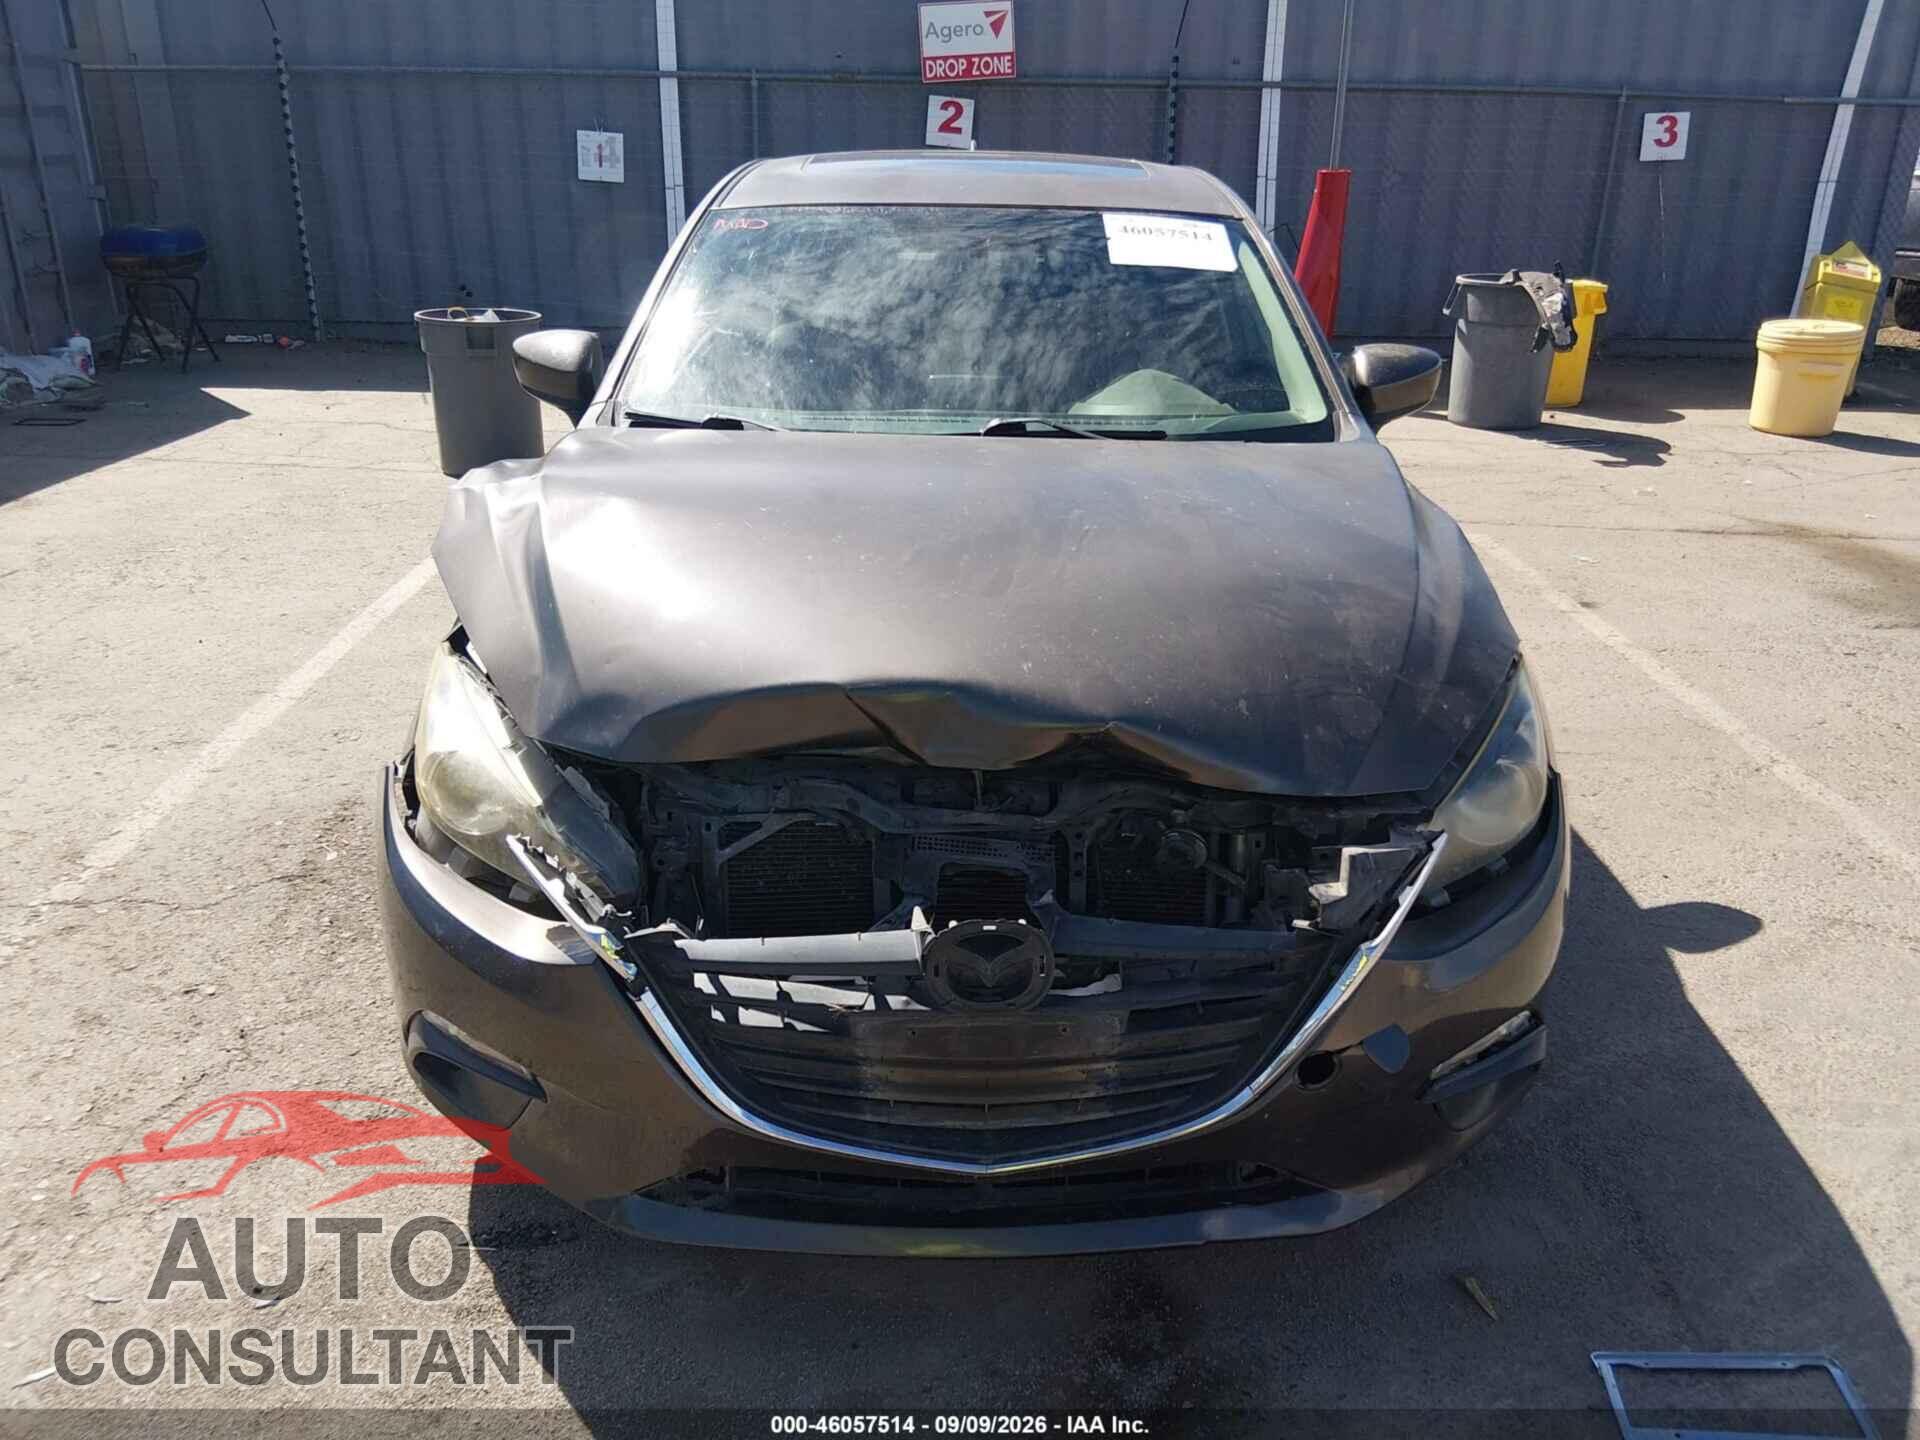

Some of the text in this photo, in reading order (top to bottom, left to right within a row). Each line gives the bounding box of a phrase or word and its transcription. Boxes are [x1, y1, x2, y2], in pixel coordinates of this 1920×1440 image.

[925, 21, 985, 43] Agero
[925, 55, 1013, 79] DROP ZONE
[937, 100, 964, 135] 2
[1653, 115, 1678, 148] 3
[1119, 224, 1214, 241] 46057514
